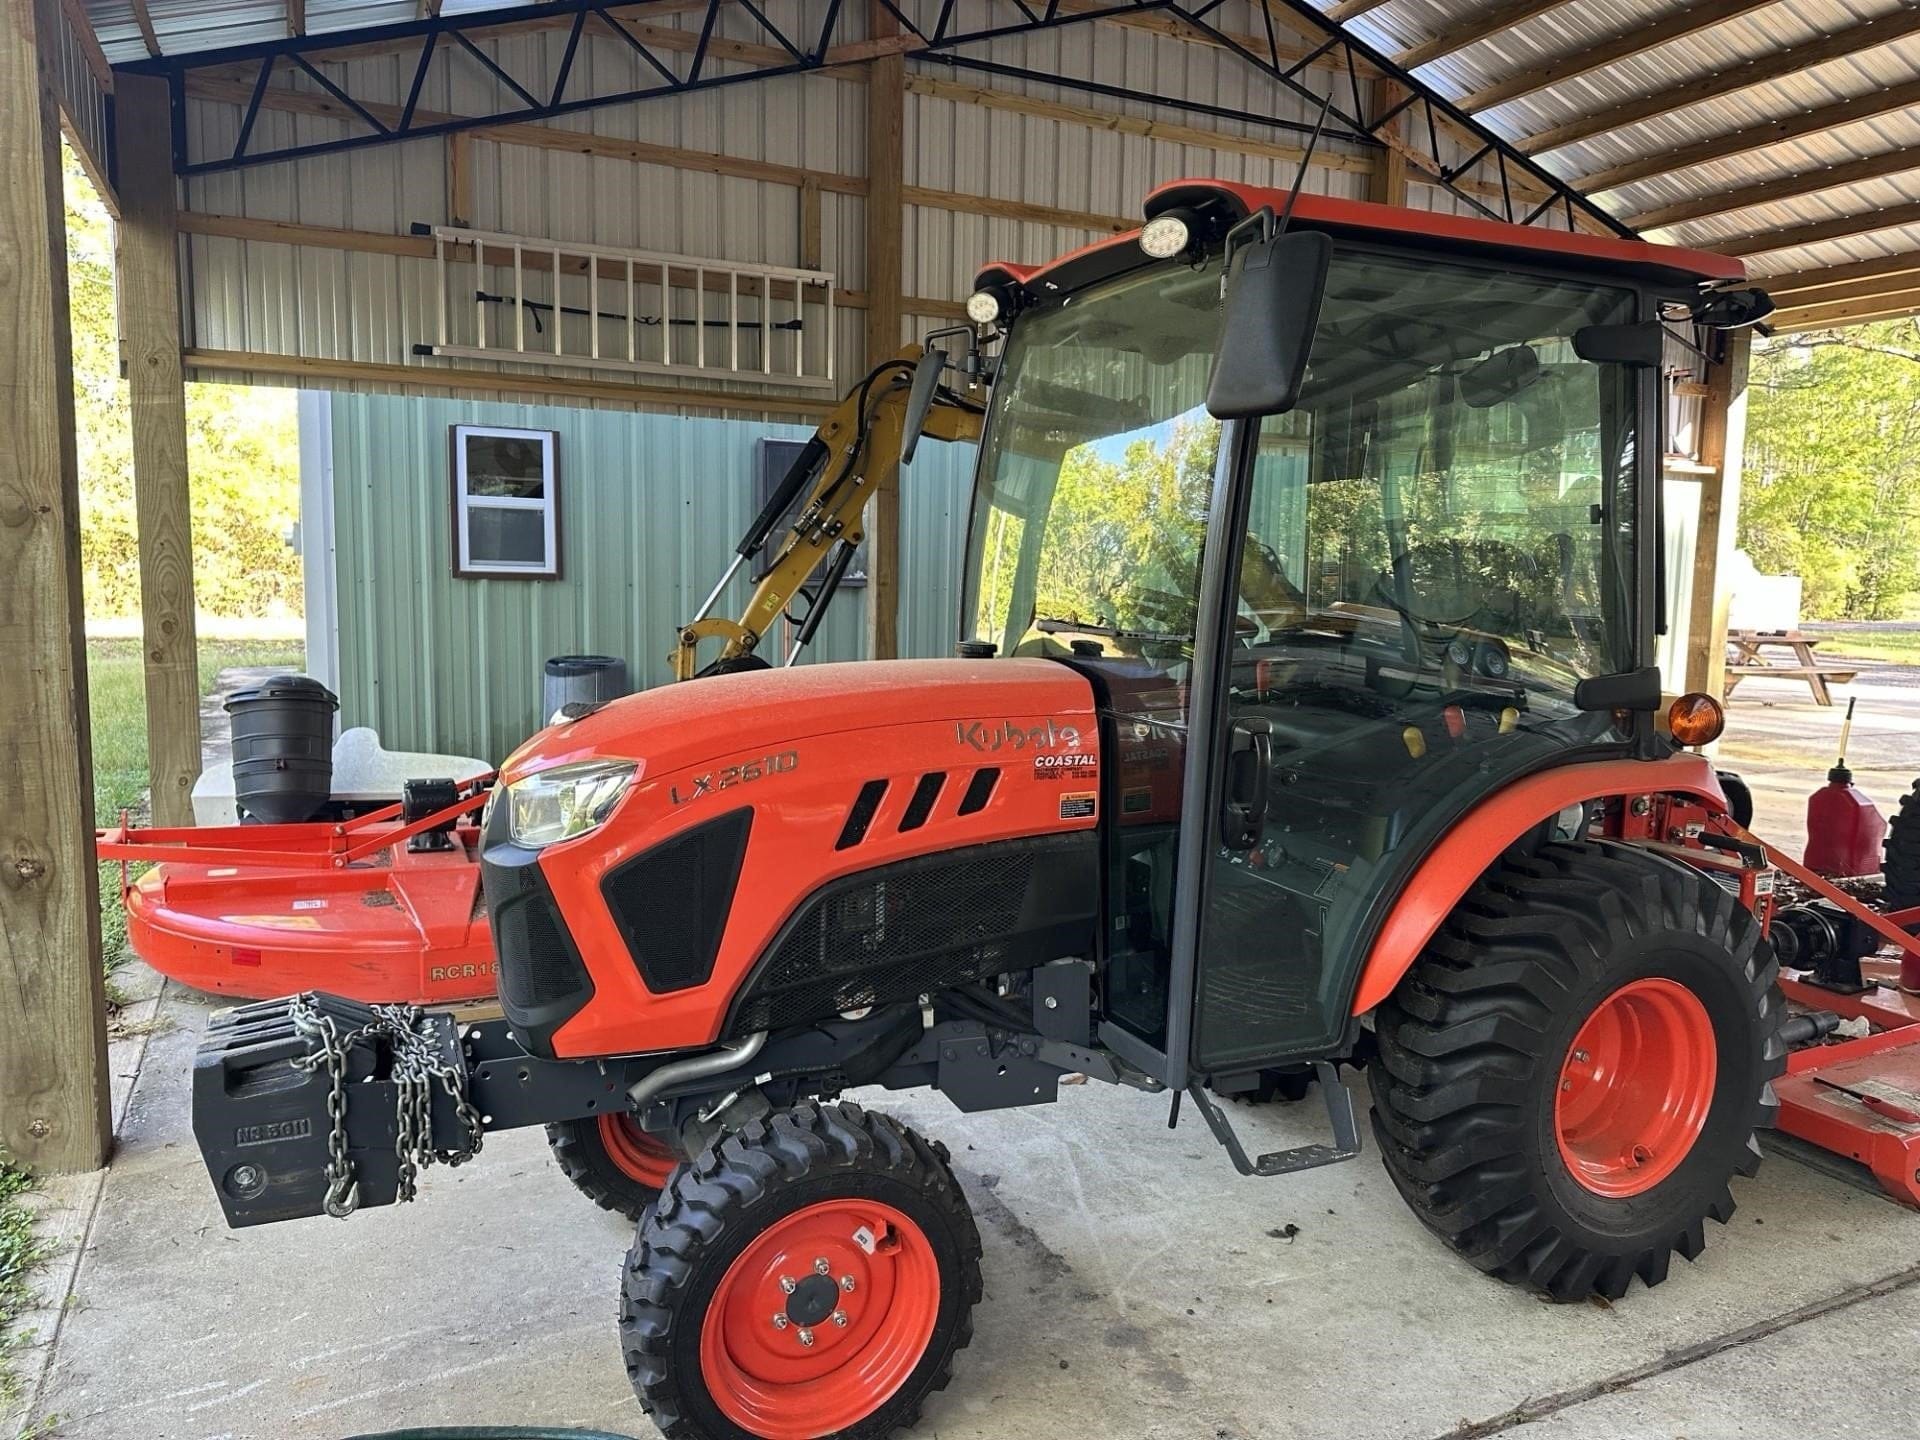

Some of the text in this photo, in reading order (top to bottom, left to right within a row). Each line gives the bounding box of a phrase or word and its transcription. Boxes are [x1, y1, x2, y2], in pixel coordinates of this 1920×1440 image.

[956, 719, 1080, 752] Kubota
[669, 750, 798, 804] LX2610
[1034, 754, 1096, 768] COASTAL
